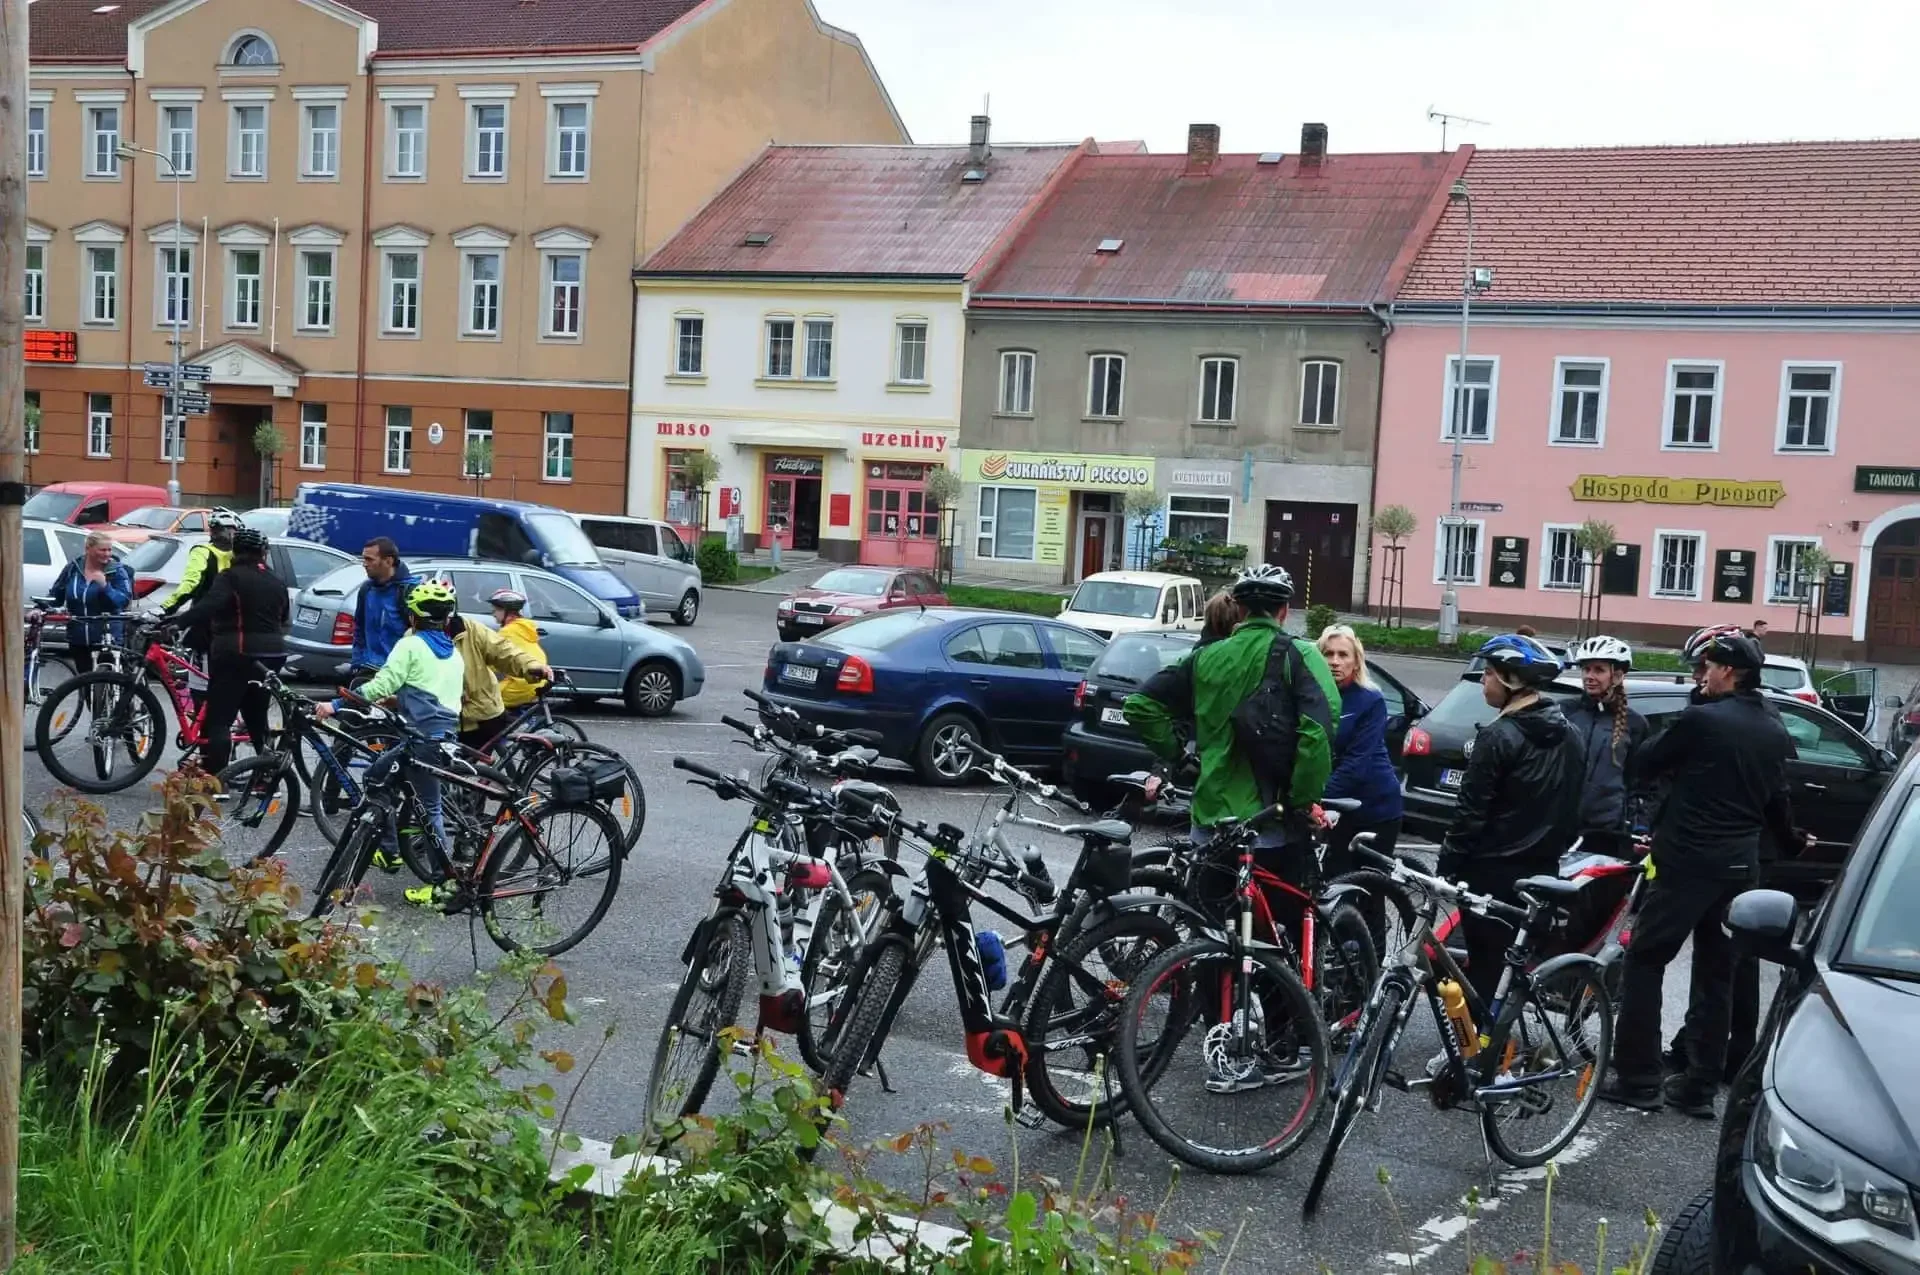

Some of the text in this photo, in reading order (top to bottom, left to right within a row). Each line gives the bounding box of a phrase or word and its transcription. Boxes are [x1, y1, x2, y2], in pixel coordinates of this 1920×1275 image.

[656, 422, 948, 453] maso uzeniny
[1090, 465, 1149, 486] PICCOLO
[1868, 472, 1916, 488] TANKOVÁ
[1581, 477, 1780, 503] Hospoda Pivovar
[1435, 996, 1461, 1057] AUTHOR
